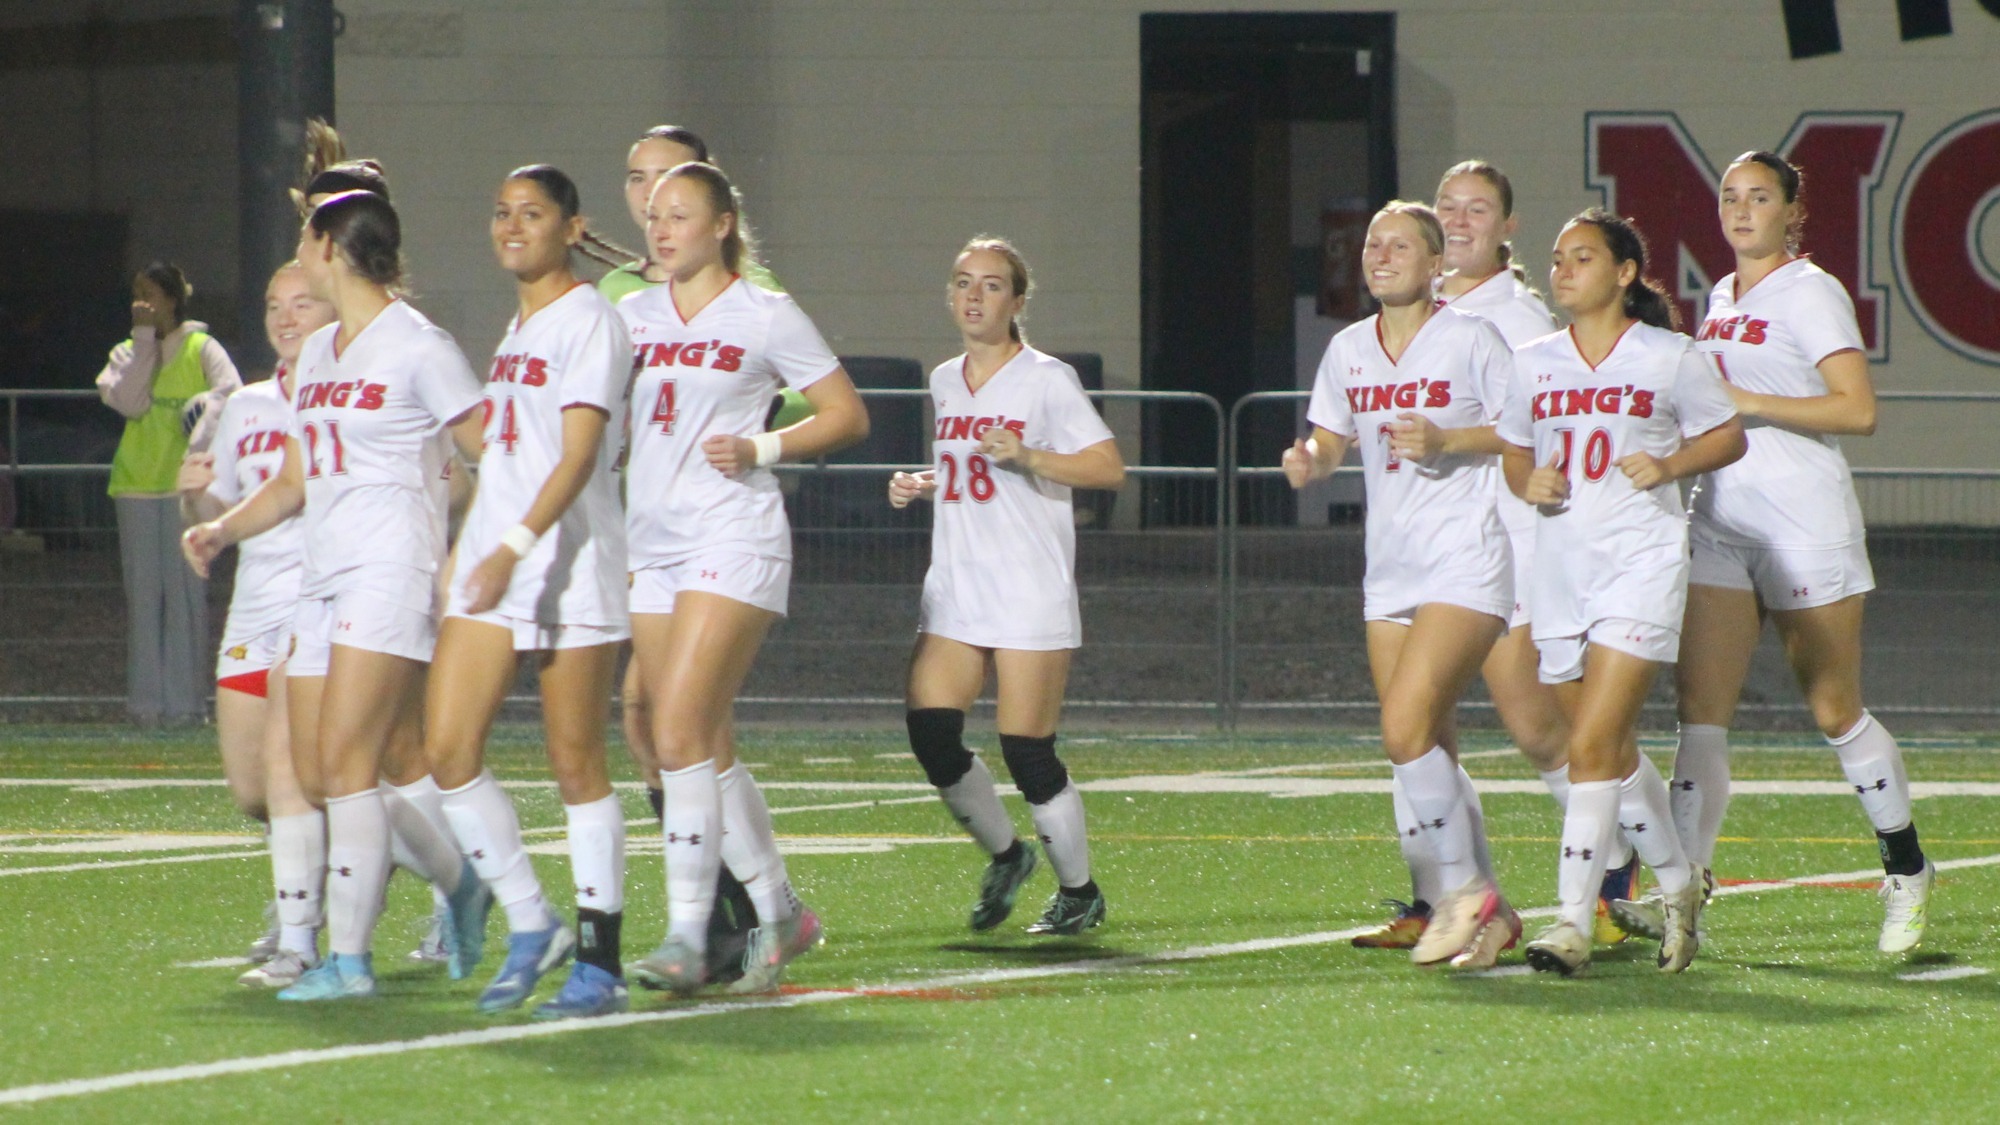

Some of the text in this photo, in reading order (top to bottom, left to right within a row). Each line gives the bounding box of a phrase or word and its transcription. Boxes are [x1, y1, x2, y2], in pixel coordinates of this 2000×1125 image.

[633, 339, 746, 372] ING'S
[297, 378, 388, 412] ING'S
[649, 378, 680, 436] 4
[1345, 378, 1451, 413] KING'S
[1531, 384, 1655, 422] KING'S
[934, 415, 1026, 441] ING'S
[1553, 426, 1614, 484] 10
[938, 450, 997, 504] 28
